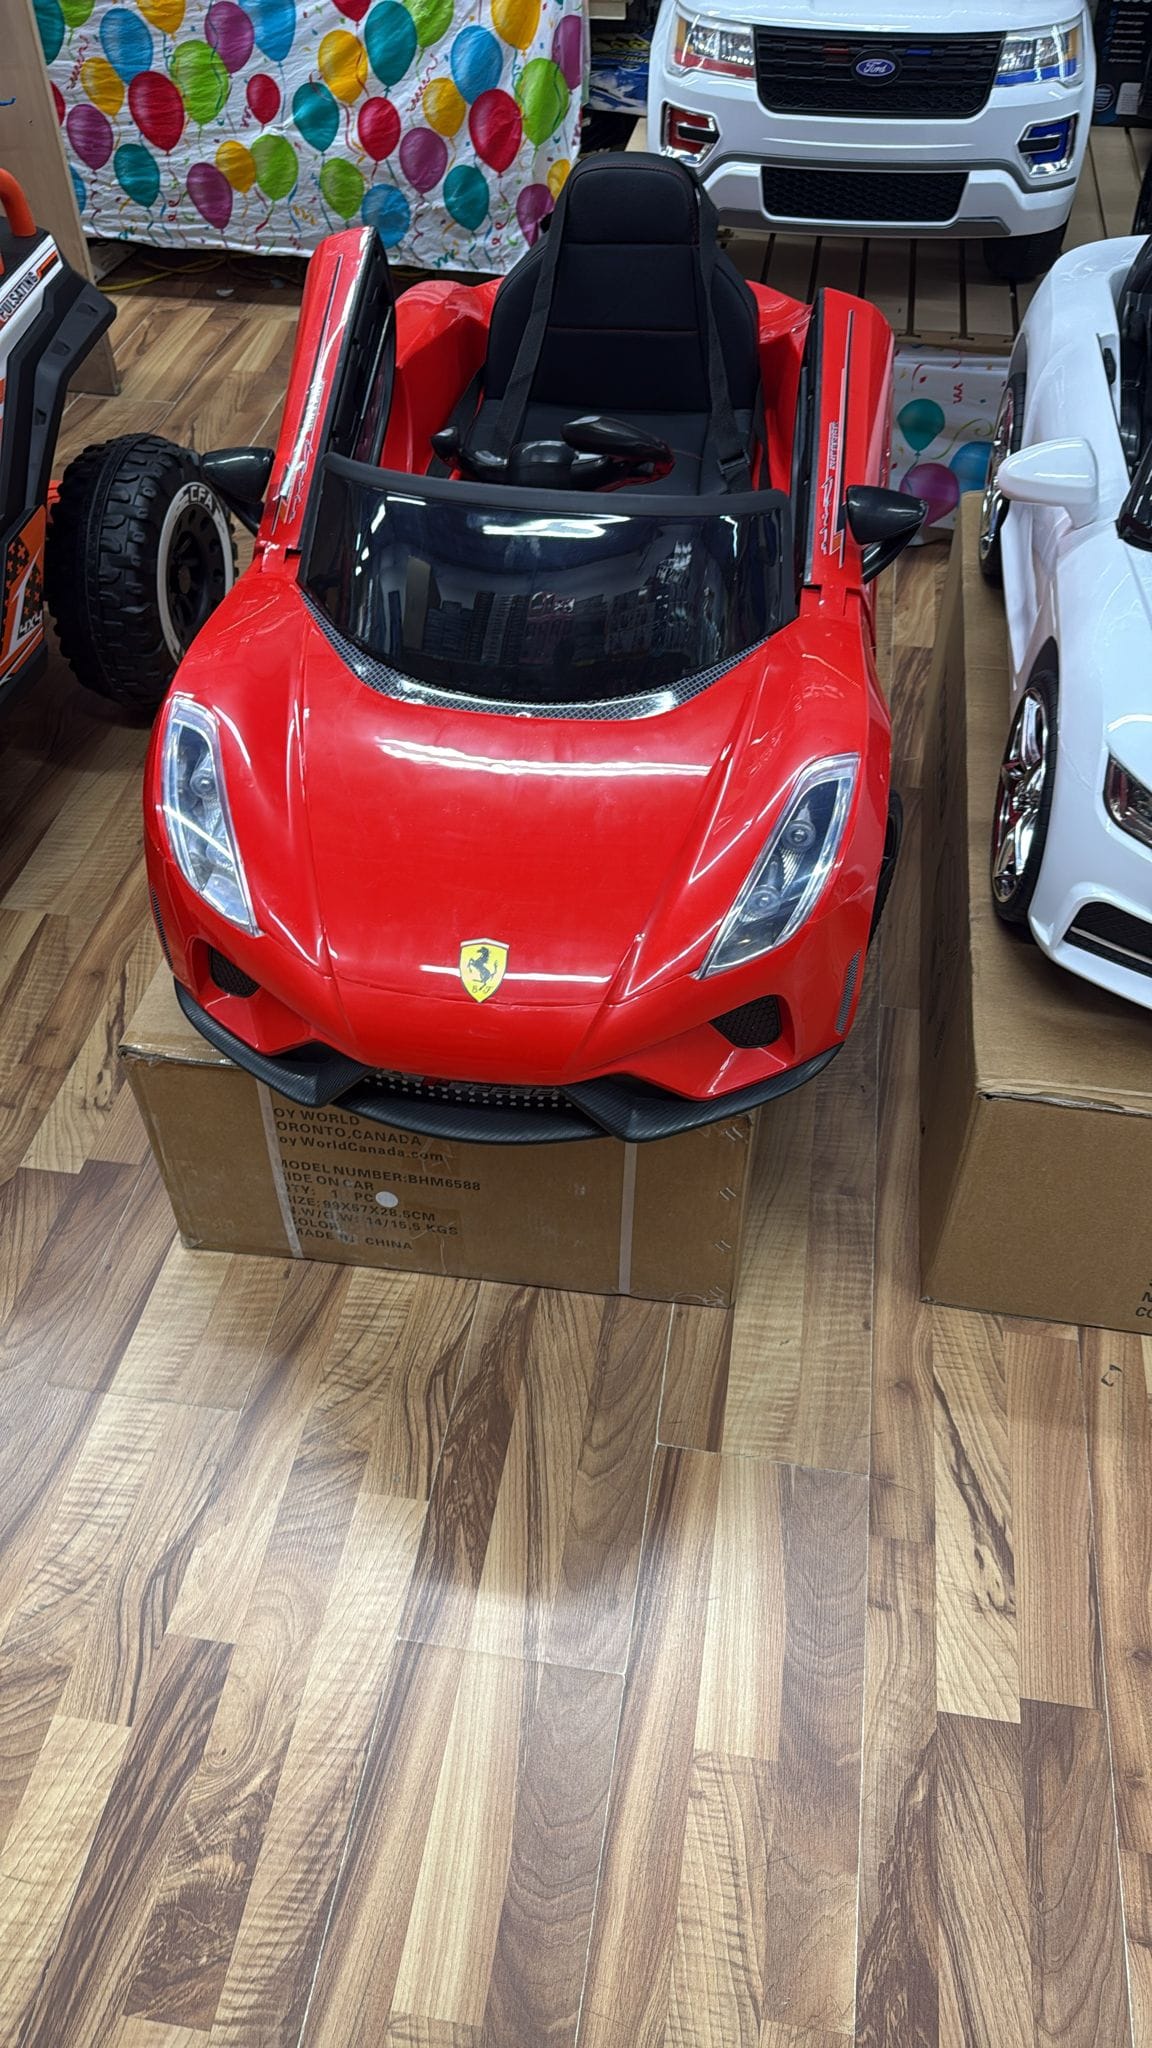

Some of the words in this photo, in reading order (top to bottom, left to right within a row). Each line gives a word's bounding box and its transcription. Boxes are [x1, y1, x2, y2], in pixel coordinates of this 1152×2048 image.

[863, 61, 888, 73] Ford
[273, 1107, 295, 1119] OY
[300, 1109, 360, 1126] WORLD
[277, 1121, 422, 1146] ORONTO,CANADA
[280, 1136, 297, 1147] oy
[300, 1136, 444, 1161] WorldCanada.com
[283, 1171, 313, 1184] IDE
[316, 1175, 340, 1187] ON
[343, 1179, 374, 1191] CAR
[333, 1165, 481, 1191] NUMBER:BHM6588
[426, 1223, 459, 1236] KGS
[364, 1237, 414, 1250] CHINA
